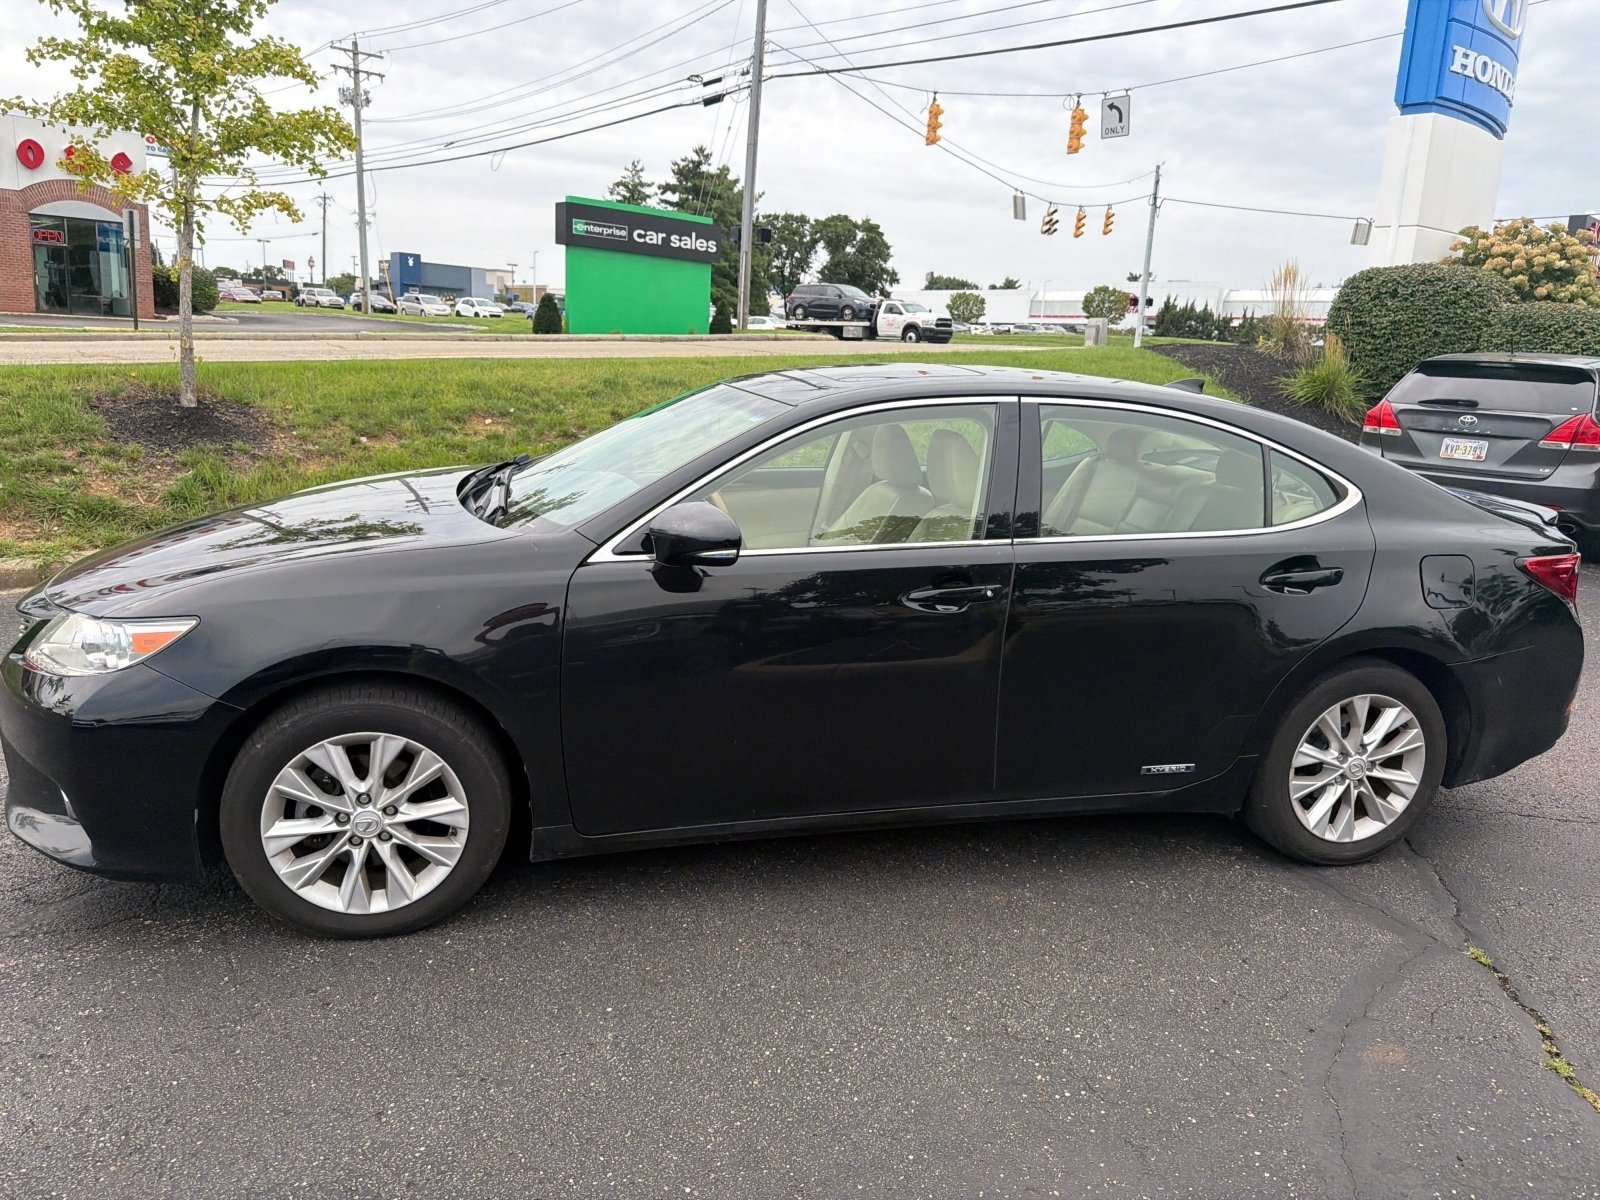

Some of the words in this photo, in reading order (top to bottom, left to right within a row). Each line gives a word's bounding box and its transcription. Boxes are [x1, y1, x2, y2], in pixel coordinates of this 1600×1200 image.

[1450, 45, 1515, 100] HOND
[1104, 125, 1125, 135] ONLY
[33, 230, 63, 242] OPEN
[576, 223, 626, 236] enterprise
[633, 229, 666, 245] car
[670, 231, 717, 253] sales
